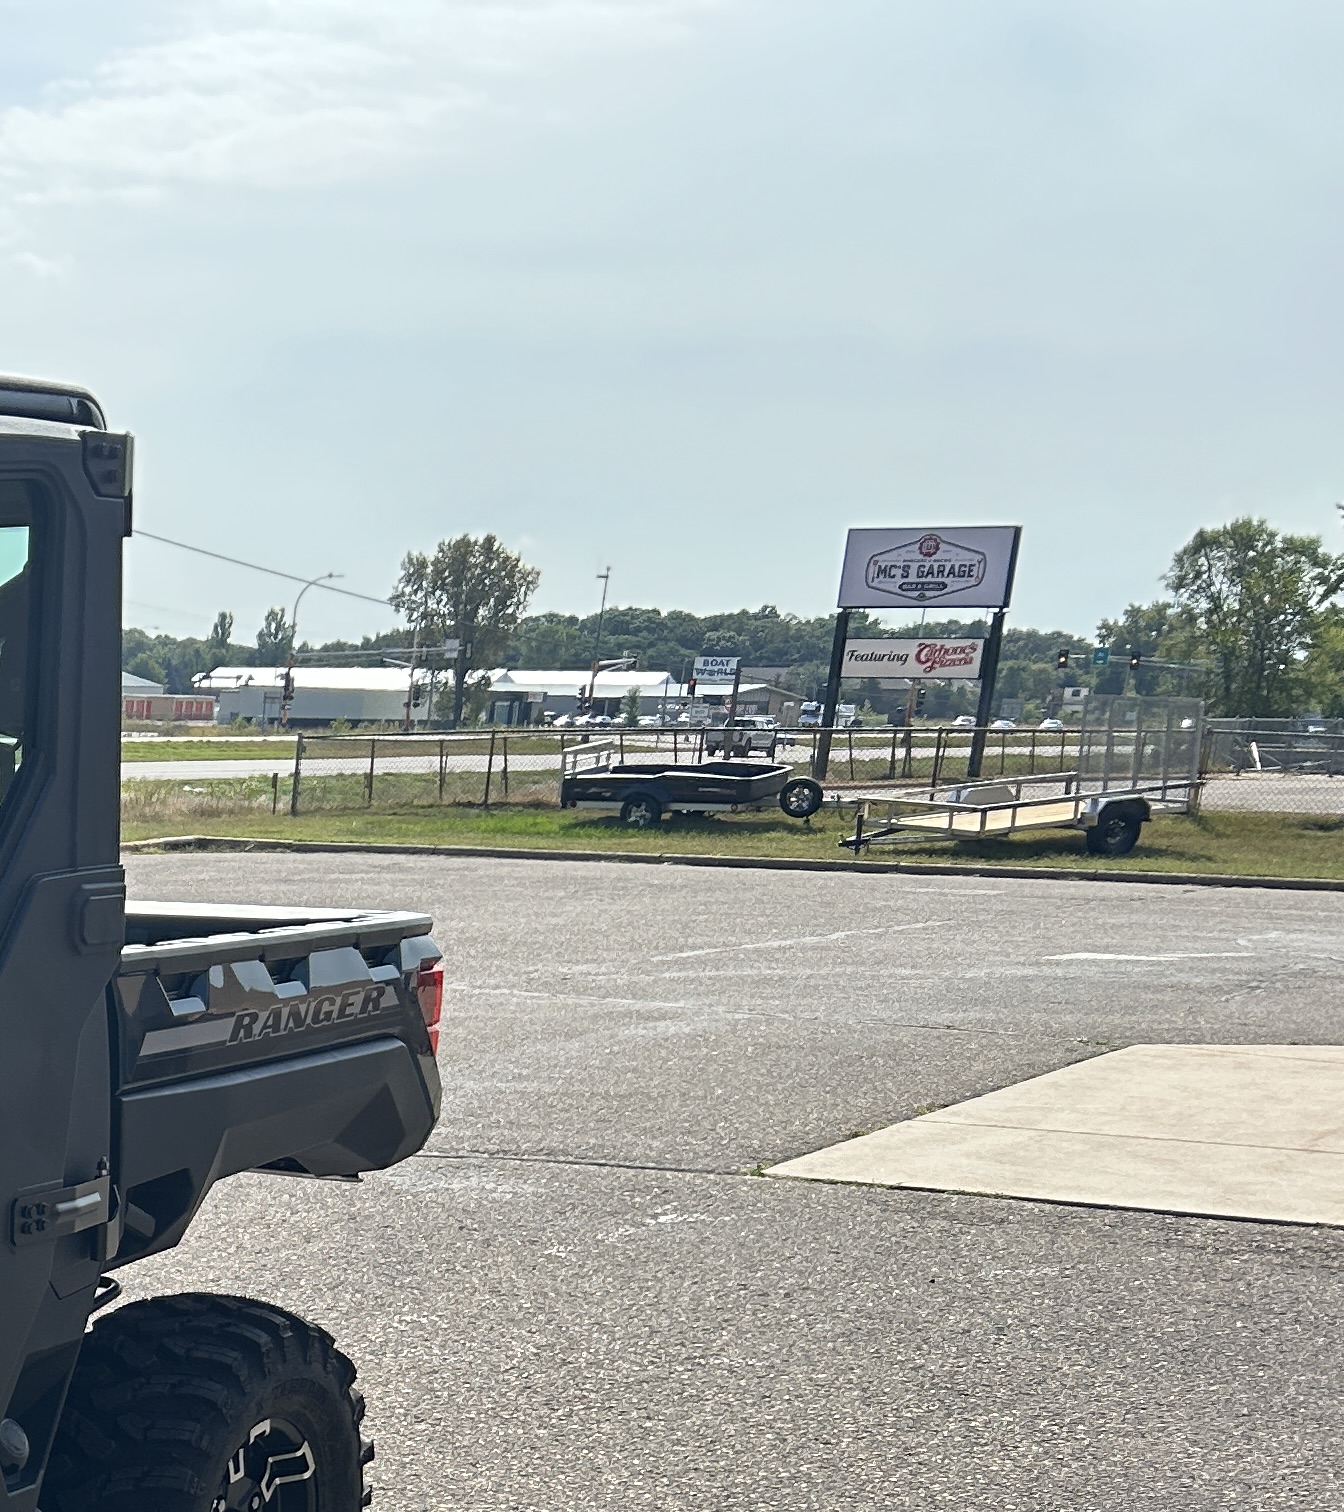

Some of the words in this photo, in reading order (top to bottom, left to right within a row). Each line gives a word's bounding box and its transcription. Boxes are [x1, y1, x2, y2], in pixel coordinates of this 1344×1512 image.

[876, 564, 911, 579] MC'S
[916, 563, 977, 579] GARAGE
[702, 658, 732, 667] BOAT
[846, 650, 910, 666] Featuring
[226, 984, 386, 1047] RANGER
